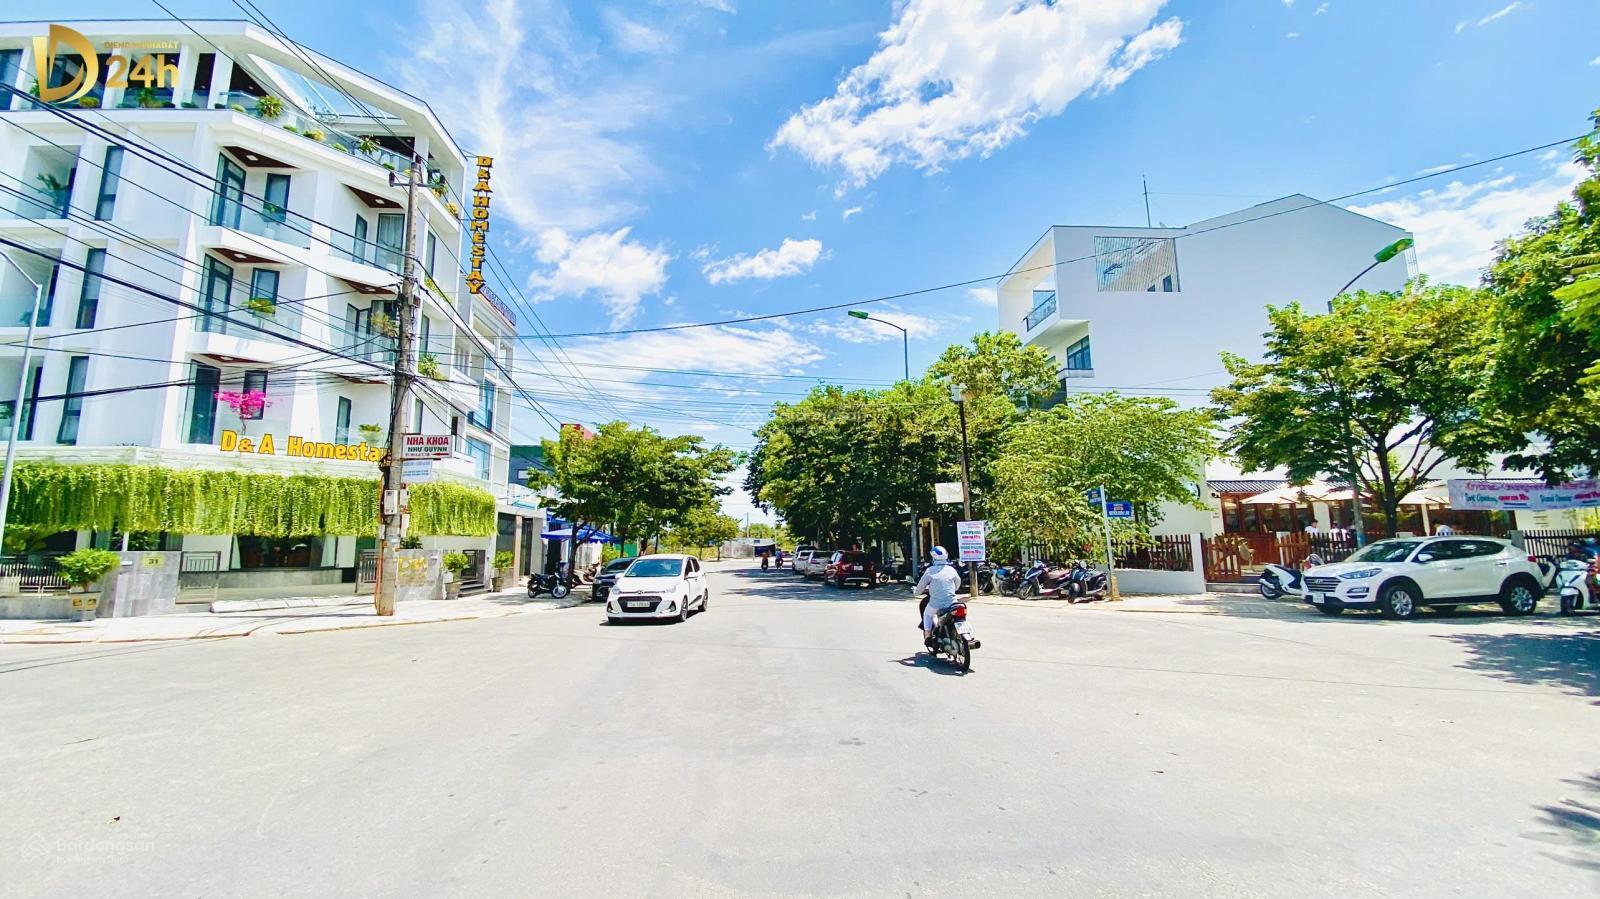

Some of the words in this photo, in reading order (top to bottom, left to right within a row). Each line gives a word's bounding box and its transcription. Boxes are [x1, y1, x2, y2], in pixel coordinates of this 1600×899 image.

[465, 195, 491, 295] HOMESTAY
[406, 437, 424, 446] NHA
[426, 437, 449, 446] KHOA
